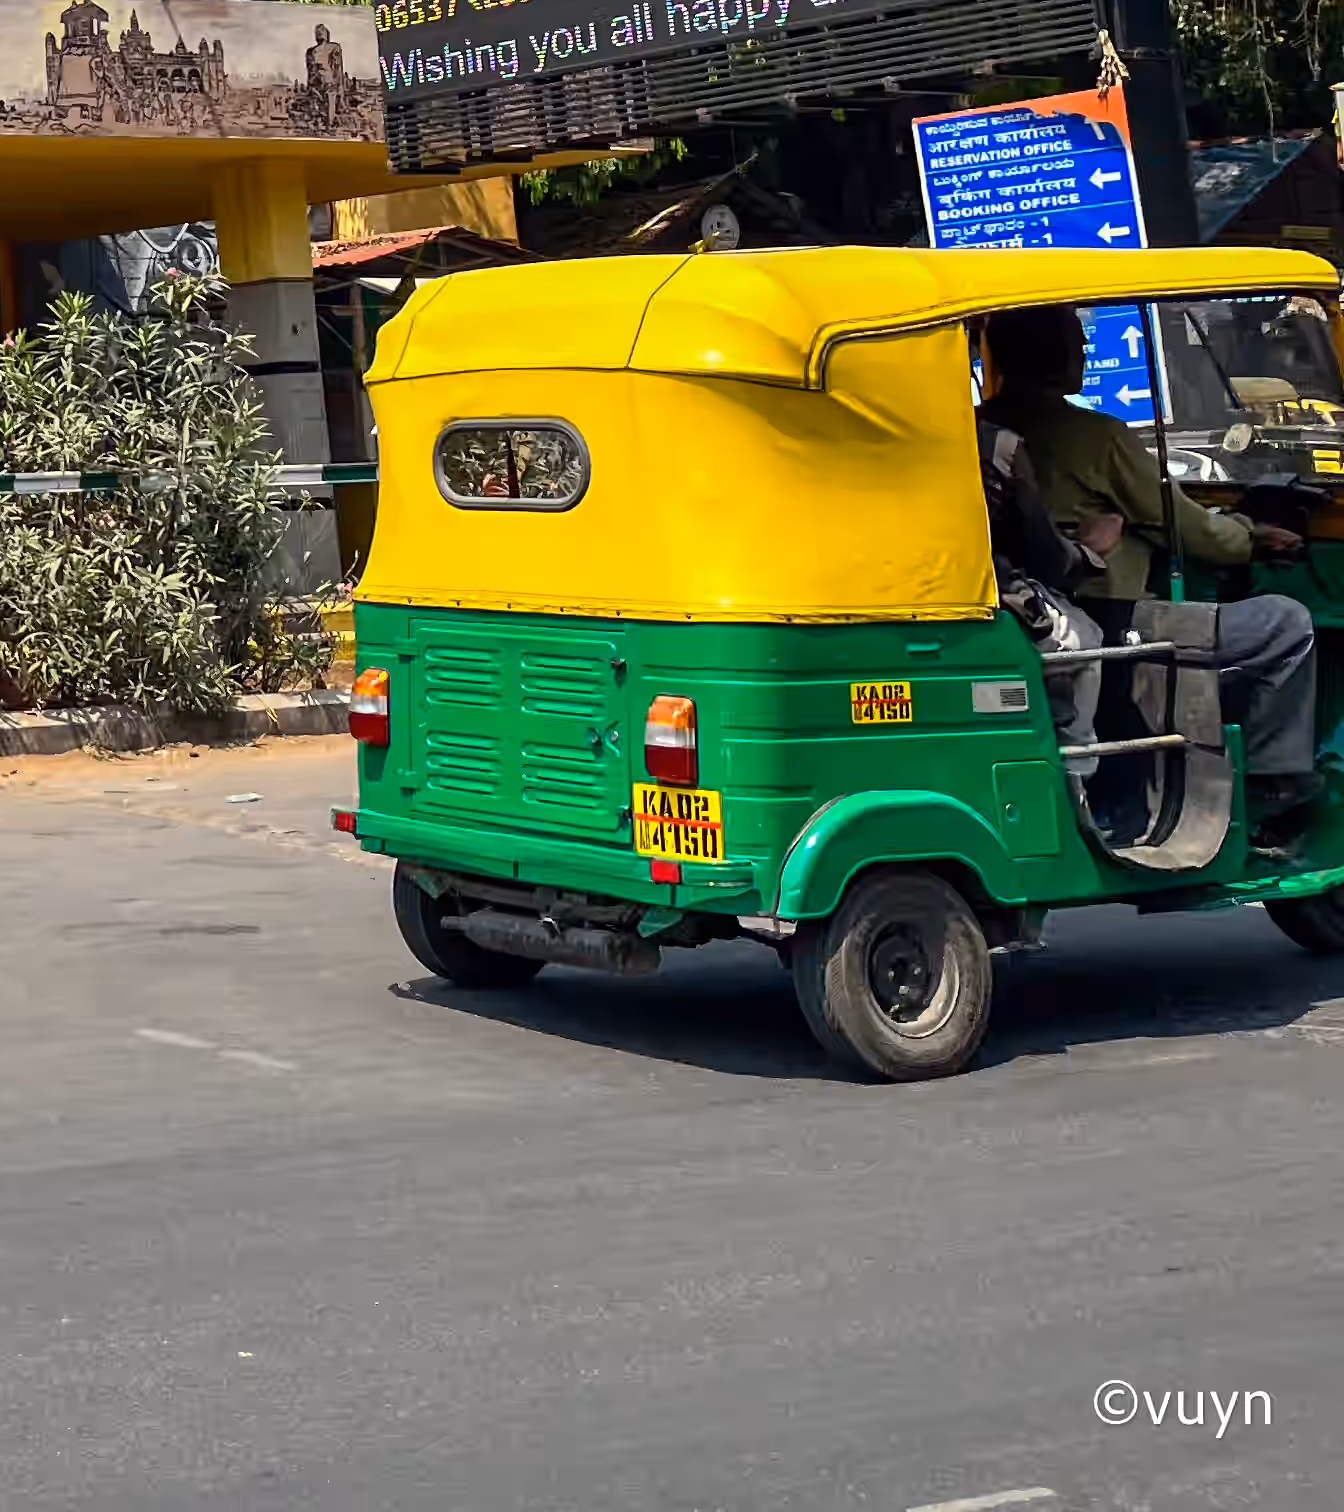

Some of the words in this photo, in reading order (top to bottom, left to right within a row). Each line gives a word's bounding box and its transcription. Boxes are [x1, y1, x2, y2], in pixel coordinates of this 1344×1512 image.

[379, 38, 520, 90] Wishing
[528, 22, 598, 73] you
[611, 1, 654, 47] all
[928, 134, 989, 153] आरक्षण
[993, 123, 1067, 143] कार्यालय
[930, 147, 1020, 169] RESERVATION
[1023, 139, 1073, 156] OFFICE
[996, 177, 1077, 197] कार्यालय
[937, 201, 1015, 221] BOOKING
[1019, 193, 1081, 210] OFFICE
